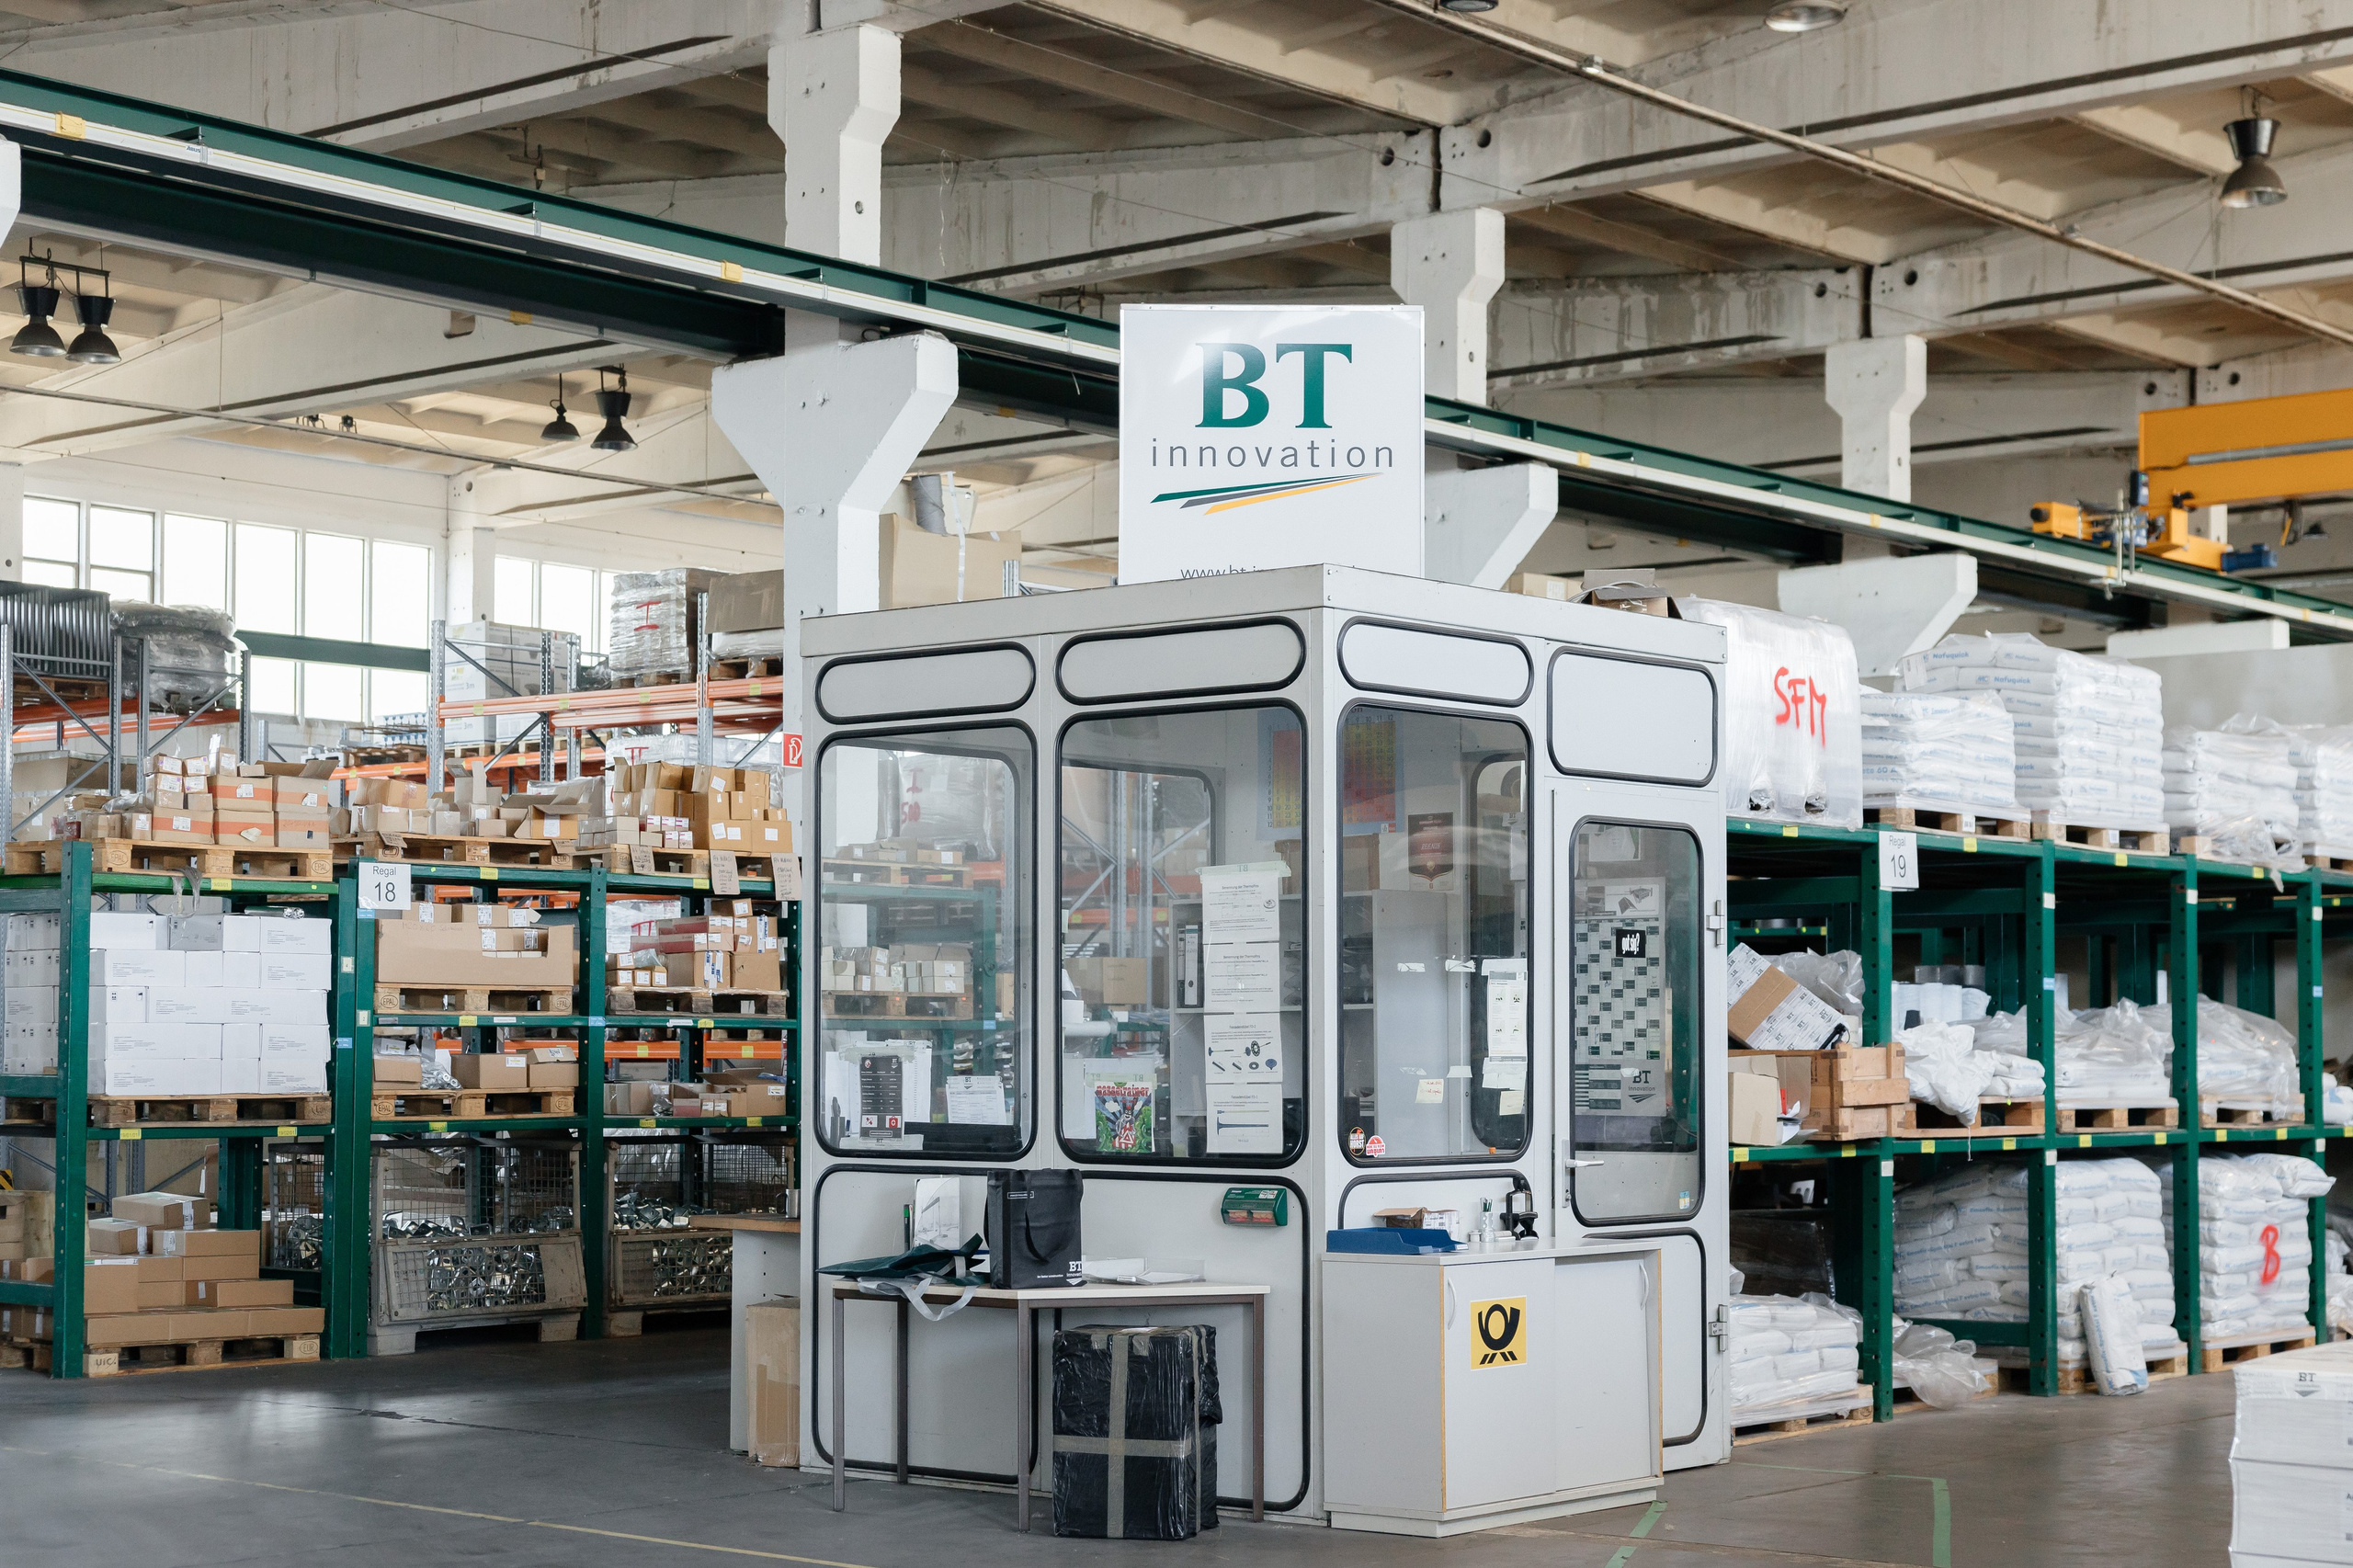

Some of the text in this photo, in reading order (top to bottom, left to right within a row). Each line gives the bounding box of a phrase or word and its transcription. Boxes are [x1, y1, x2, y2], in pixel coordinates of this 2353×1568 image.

[1195, 343, 1353, 428] BT
[1152, 437, 1393, 468] innovation
[1774, 666, 1827, 748] SFM
[1889, 835, 1907, 847] Regal
[372, 865, 397, 876] Regal
[1890, 854, 1907, 879] 19
[374, 881, 396, 903] 18
[382, 995, 396, 1006] EPAL
[1632, 1070, 1651, 1084] BT
[2298, 1372, 2317, 1382] BT
